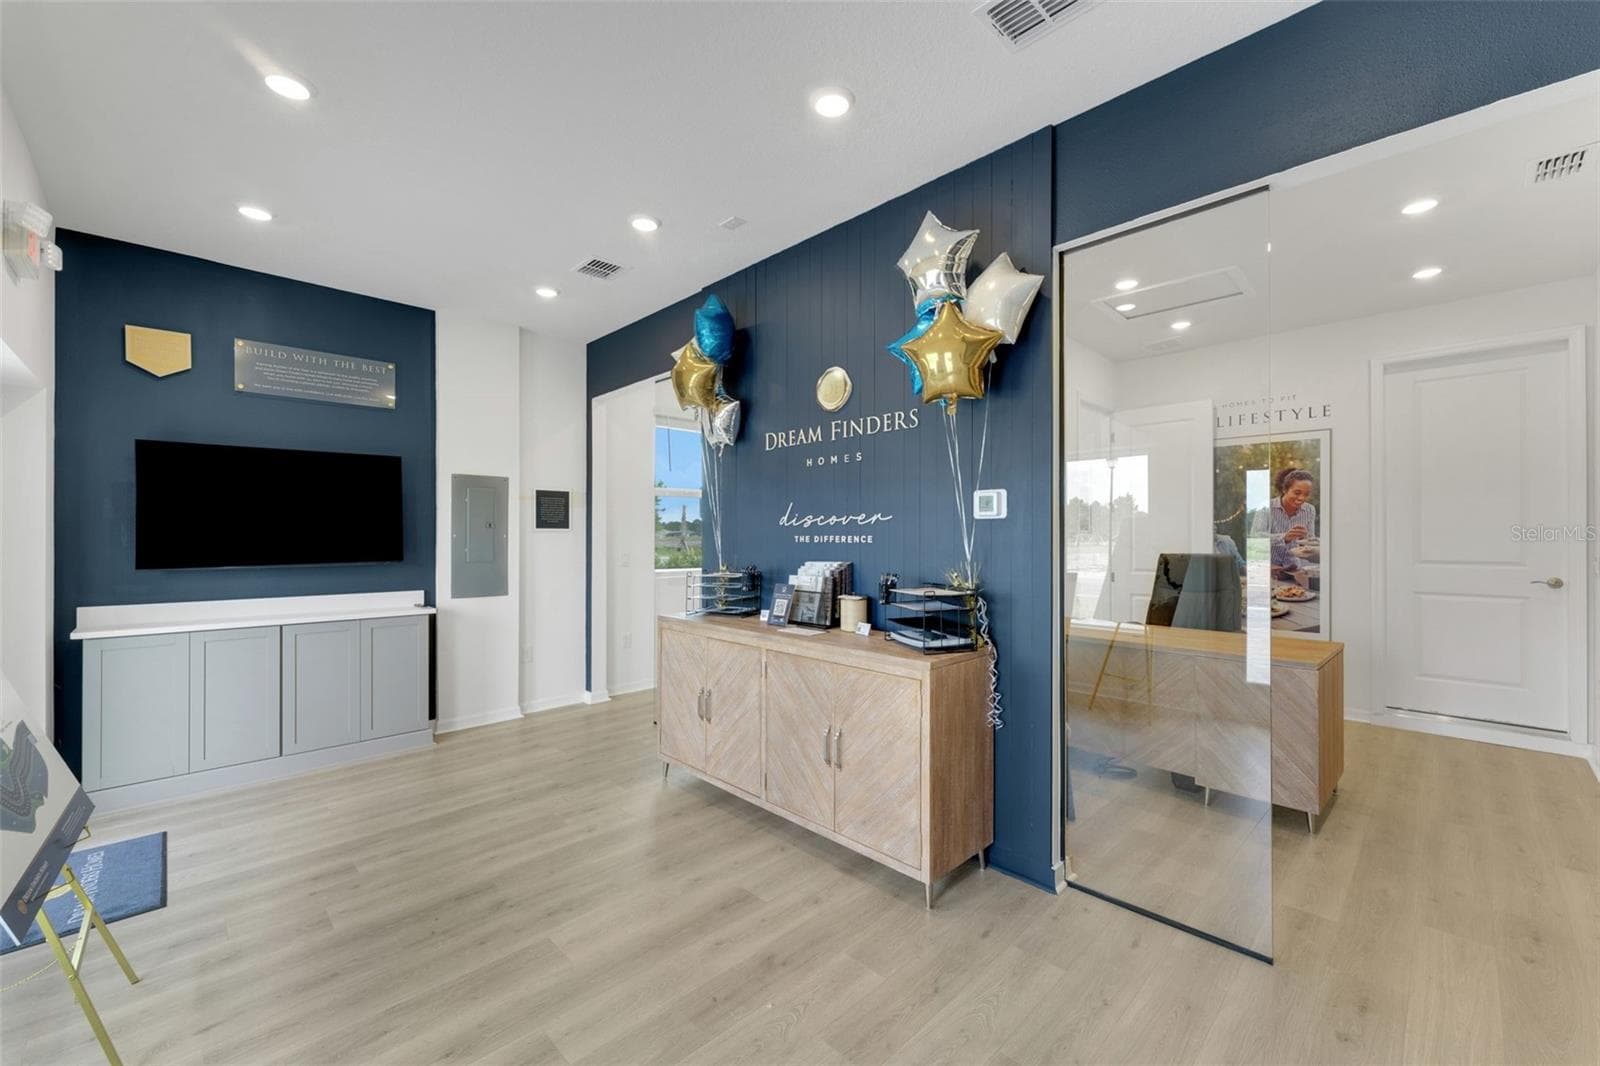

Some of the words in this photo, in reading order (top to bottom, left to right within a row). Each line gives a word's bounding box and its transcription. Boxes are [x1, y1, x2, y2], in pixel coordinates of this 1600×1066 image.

[245, 346, 287, 359] BUILD
[293, 352, 327, 366] WITH
[335, 358, 356, 370] THE
[361, 363, 387, 376] BEST
[1216, 404, 1332, 428] LIFESTYLE
[764, 425, 823, 451] DREAM
[830, 408, 920, 441] FINDERS
[805, 452, 863, 467] HOMES
[778, 502, 893, 528] discover
[793, 535, 811, 544] THE
[813, 535, 873, 544] DIFFERENCE
